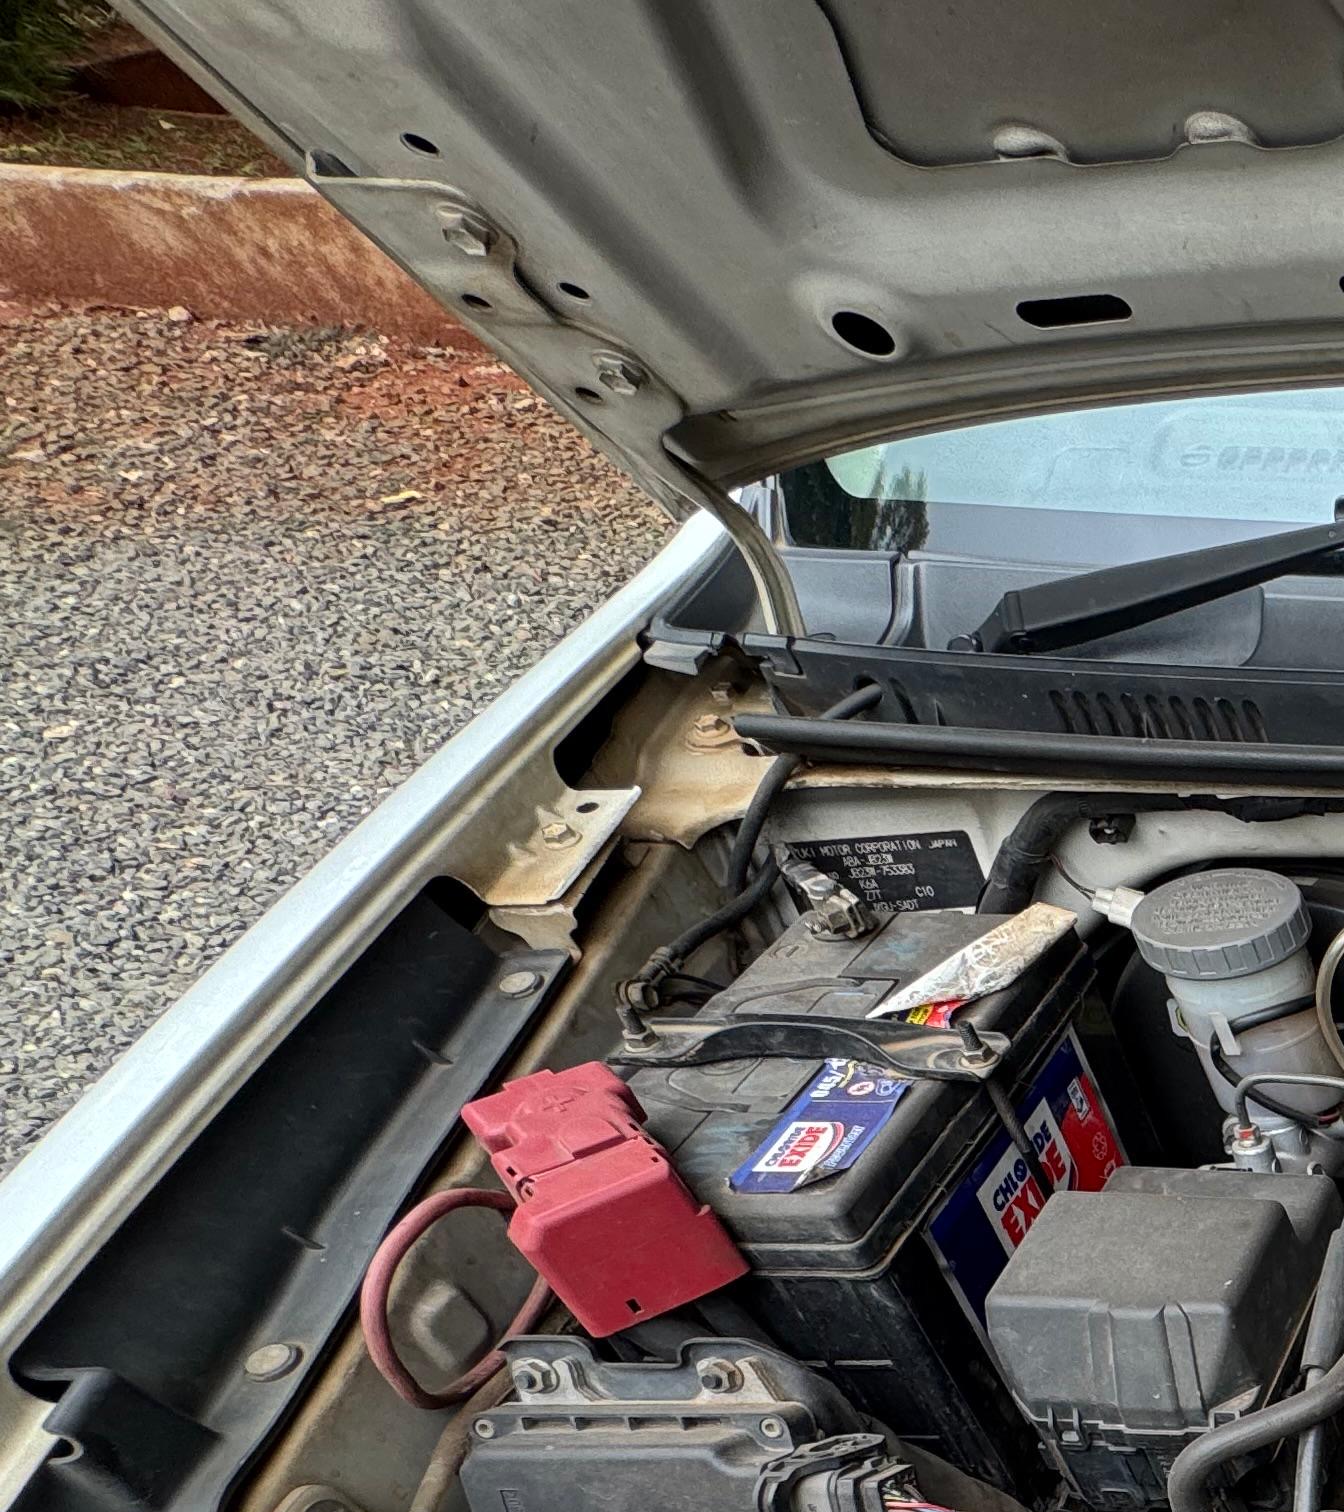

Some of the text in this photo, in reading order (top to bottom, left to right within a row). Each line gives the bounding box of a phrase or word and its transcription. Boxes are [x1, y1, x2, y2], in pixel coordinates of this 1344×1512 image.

[821, 843, 851, 857] MOTOR
[855, 839, 921, 854] CORPORATION
[779, 1125, 829, 1168] EXIDE
[993, 1120, 1051, 1212] CHLODE
